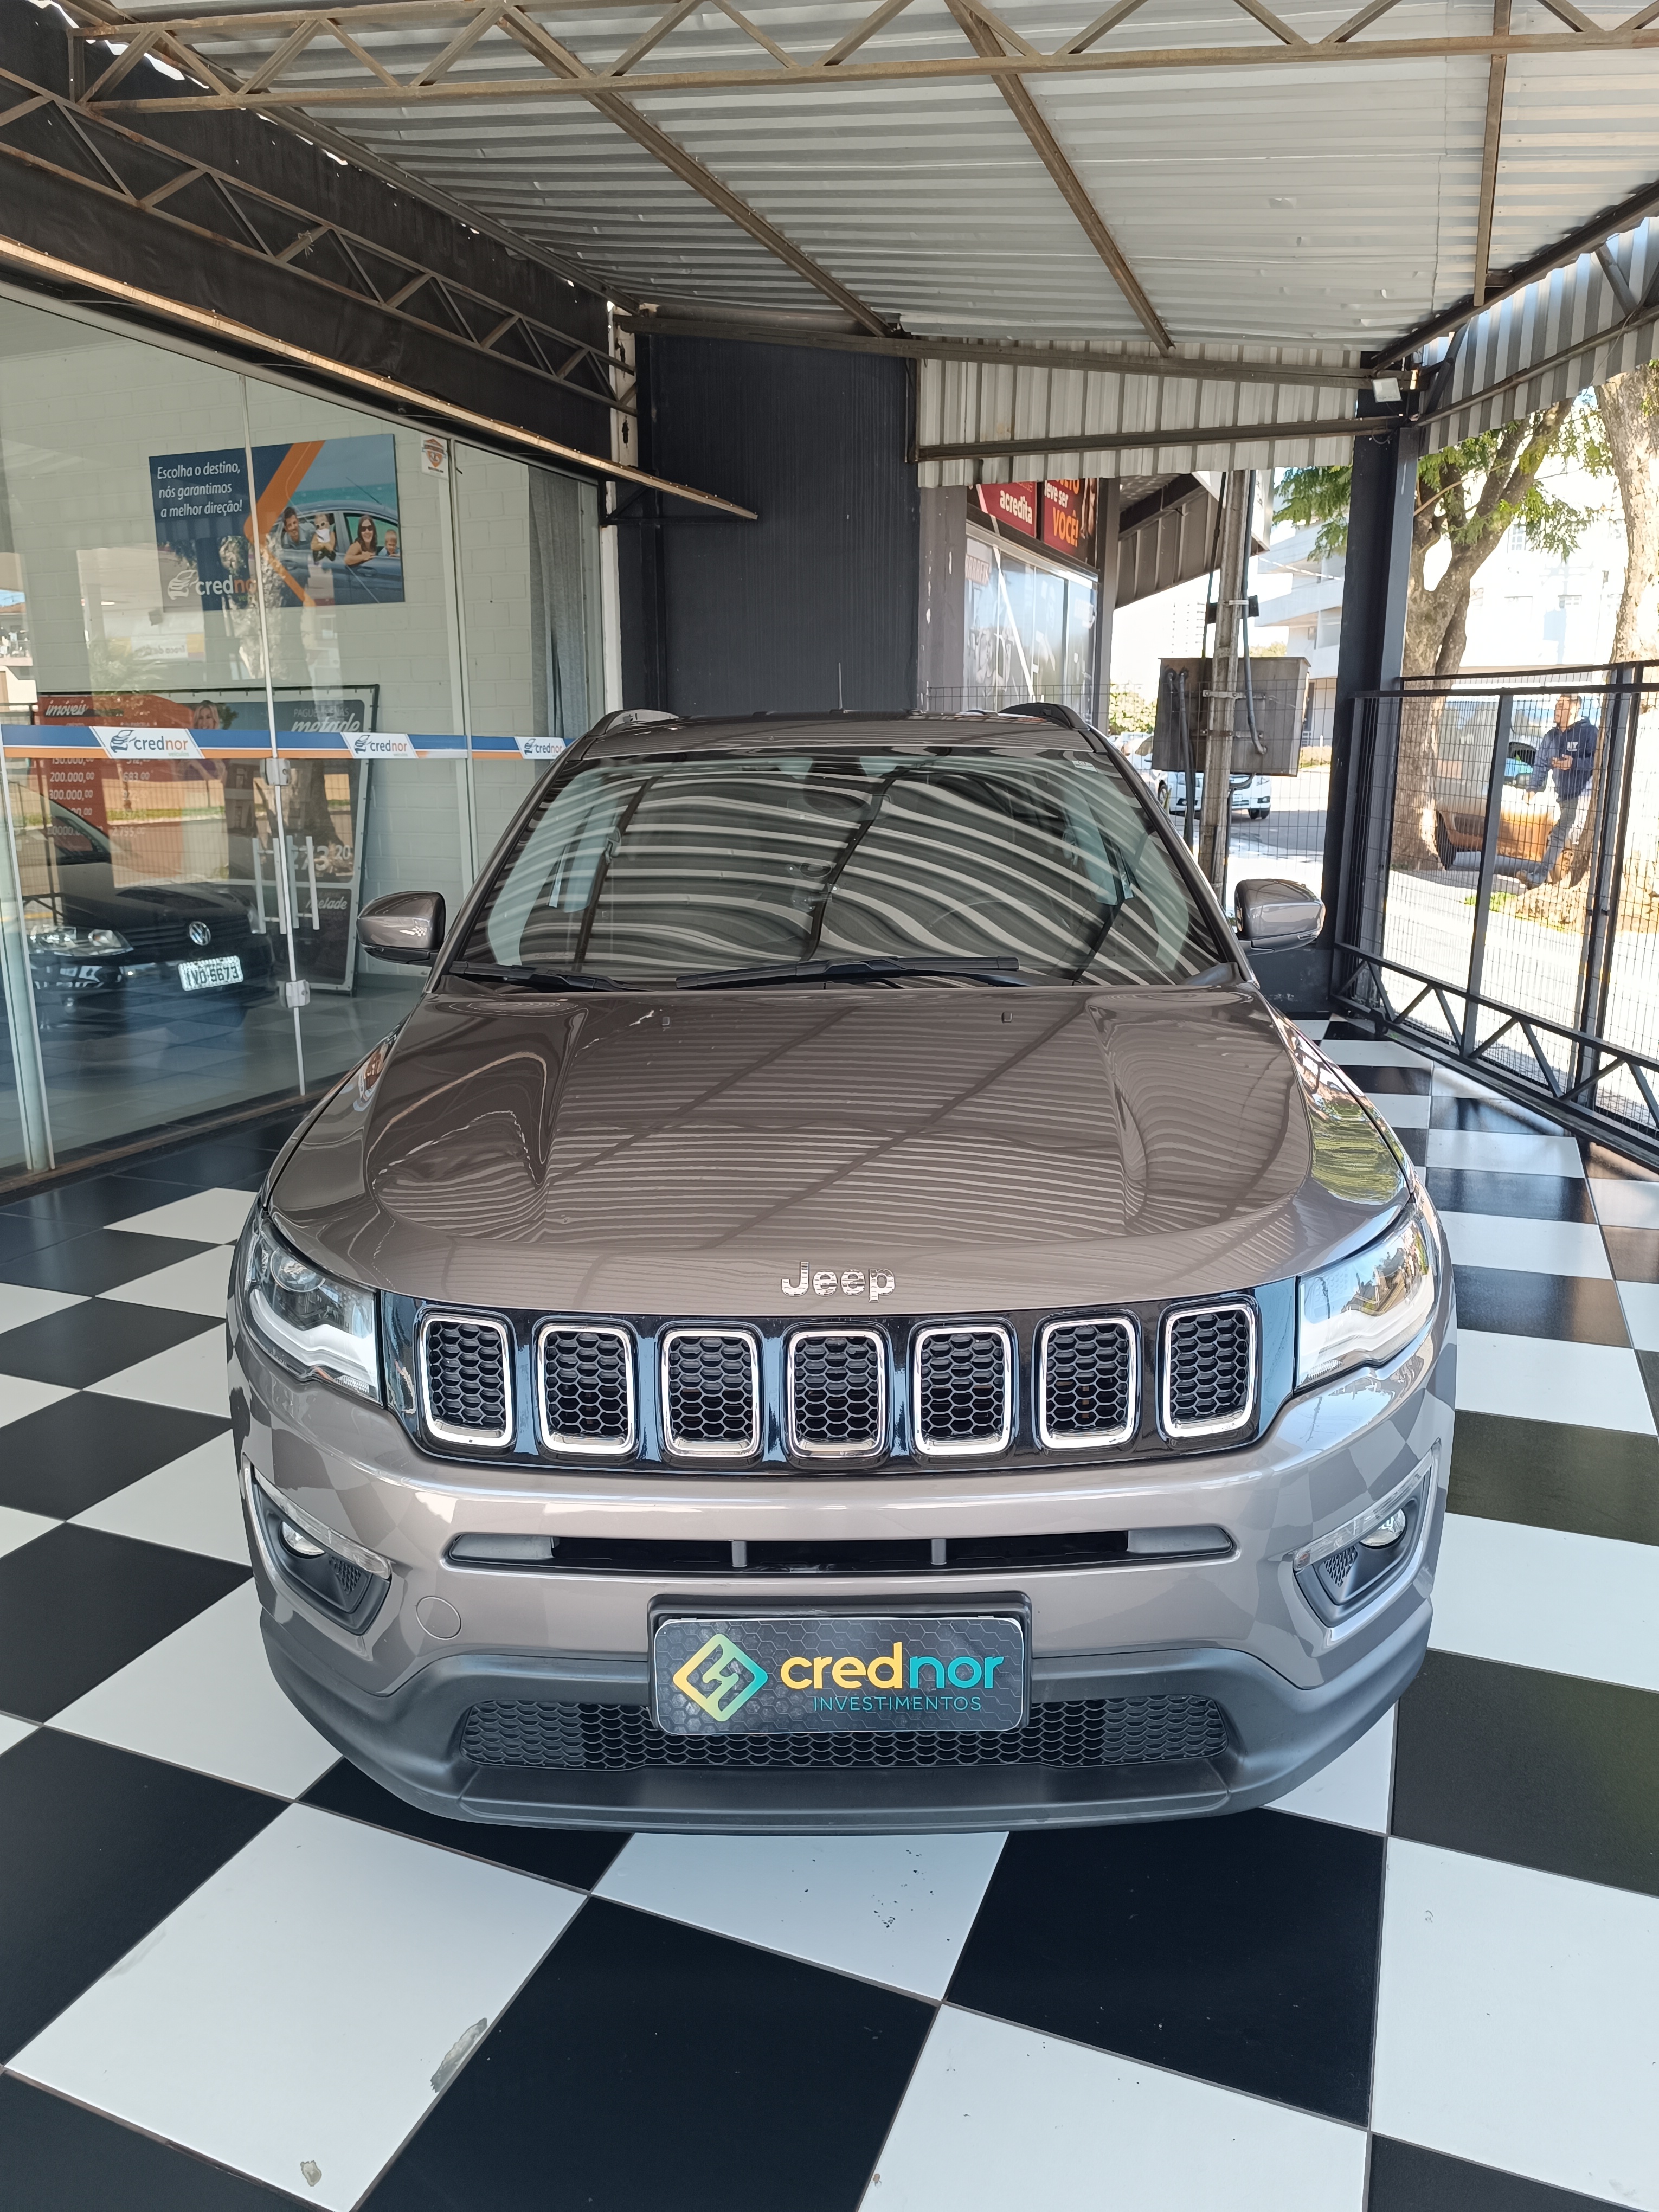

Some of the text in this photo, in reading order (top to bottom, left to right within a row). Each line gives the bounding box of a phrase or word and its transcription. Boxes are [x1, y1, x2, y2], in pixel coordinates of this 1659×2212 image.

[157, 461, 240, 479] Escolha o destino,
[159, 483, 232, 500] nós garantimos
[1058, 490, 1069, 509] ser
[160, 499, 242, 517] a melhor direção!
[1000, 490, 1033, 524] acredita
[1053, 507, 1079, 547] VOCÊ!
[195, 575, 258, 595] credno
[46, 700, 88, 716] imóveis
[134, 736, 188, 750] crednor
[370, 740, 407, 752] crednor
[535, 743, 562, 753] crednor
[50, 772, 95, 783] 200.000,00
[781, 1261, 895, 1303] Jeep
[780, 1642, 1005, 1690] crednor
[814, 1696, 982, 1711] INVESTIMENTOS
